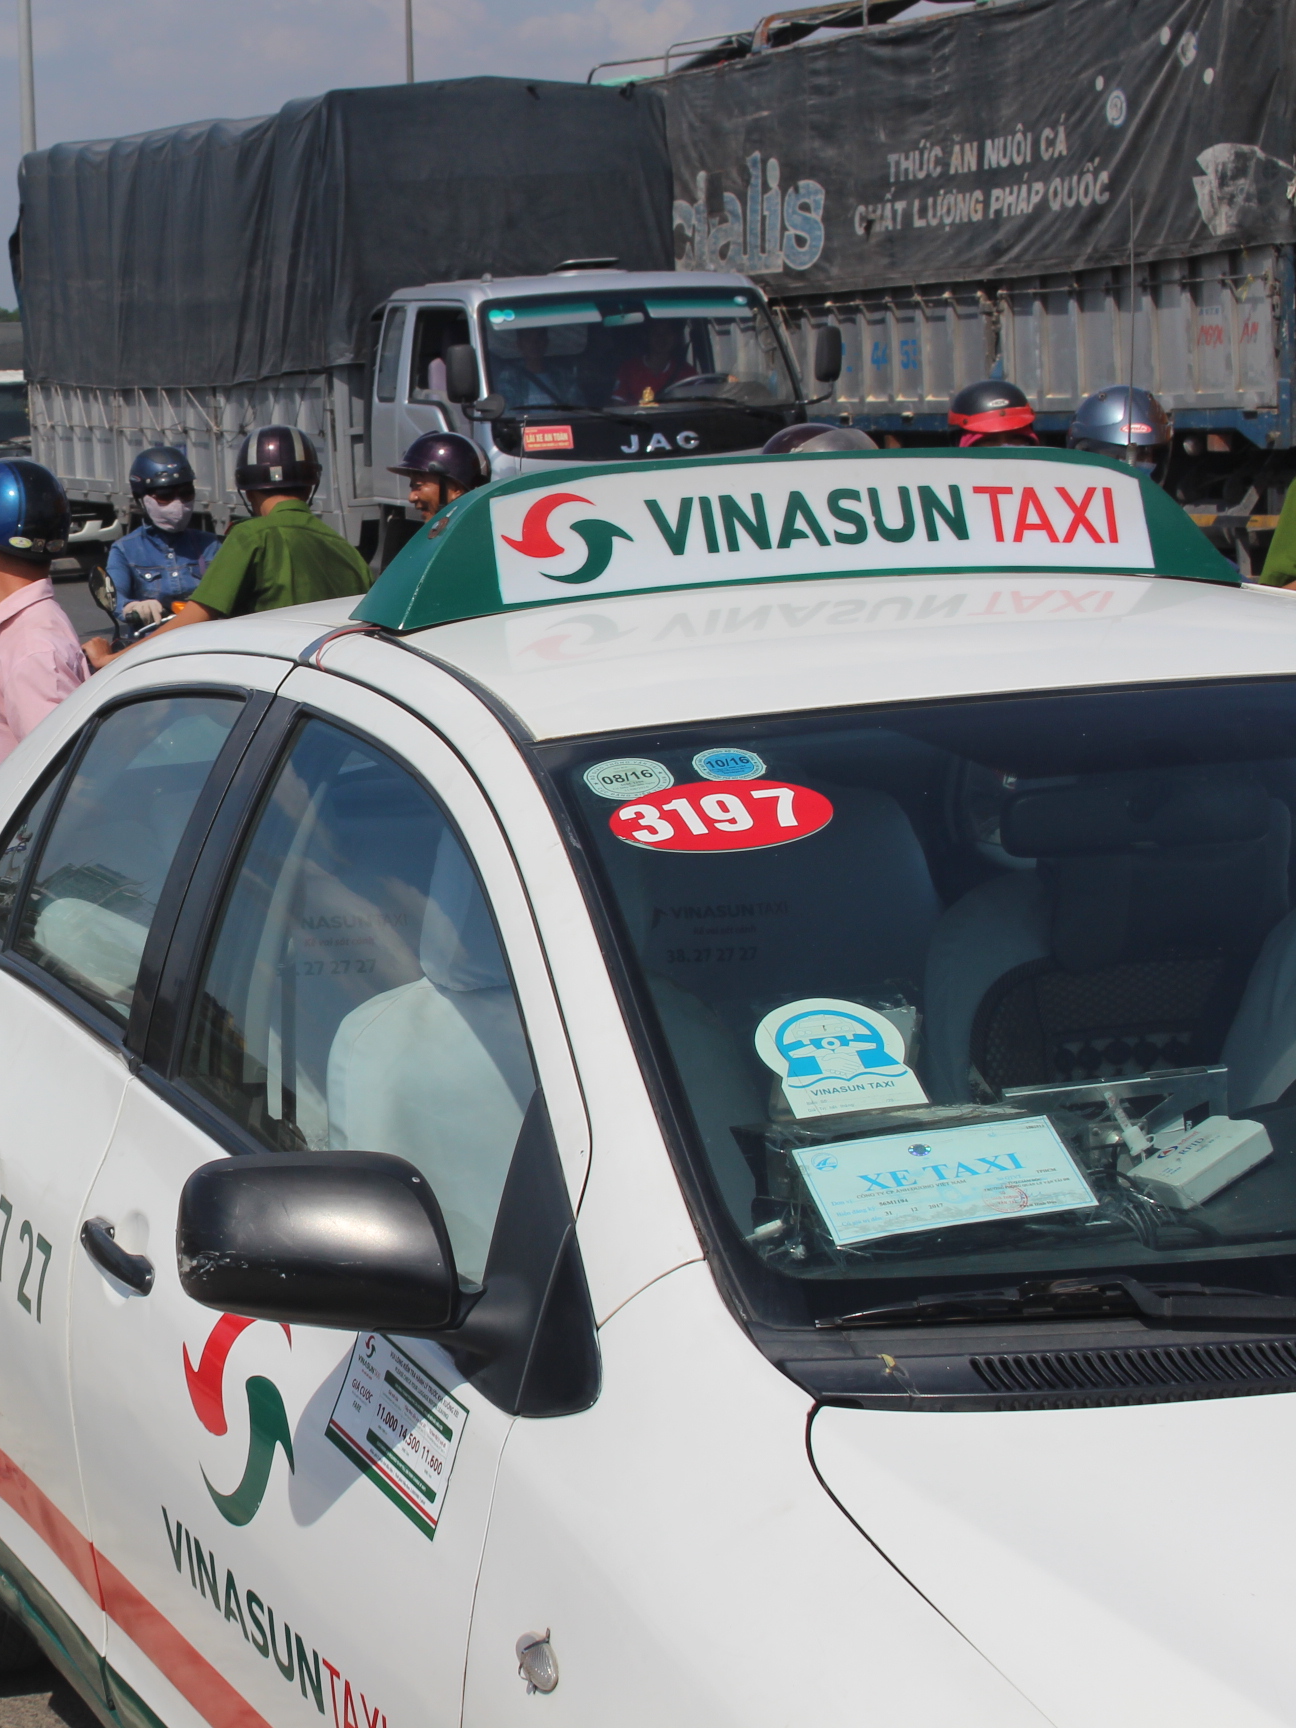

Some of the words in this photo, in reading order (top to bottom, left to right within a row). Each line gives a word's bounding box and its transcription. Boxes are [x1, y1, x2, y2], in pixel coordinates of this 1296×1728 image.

[887, 139, 943, 182] THỨC
[950, 134, 978, 175] ĂN
[984, 123, 1032, 170] NUÔI
[1040, 113, 1068, 161] CÁ
[855, 187, 907, 235] CHẤT
[913, 188, 984, 231] LƯỢNG
[990, 172, 1045, 219] PHÁP
[1048, 157, 1109, 211] QUỐC
[620, 430, 701, 454] JAC
[601, 769, 654, 785] 08/16
[706, 756, 751, 769] 10/16
[618, 787, 799, 843] 3197
[356, 958, 376, 973] 27
[810, 1083, 866, 1097] VINASUN
[867, 1080, 896, 1090] TAXI
[856, 1169, 918, 1192] XE
[922, 1152, 1026, 1181] TAXI
[17, 1219, 53, 1325] 27
[351, 1398, 361, 1414] FARE
[375, 1402, 398, 1433] 11.000
[397, 1423, 421, 1455] 14.500
[419, 1444, 443, 1476] 11.600
